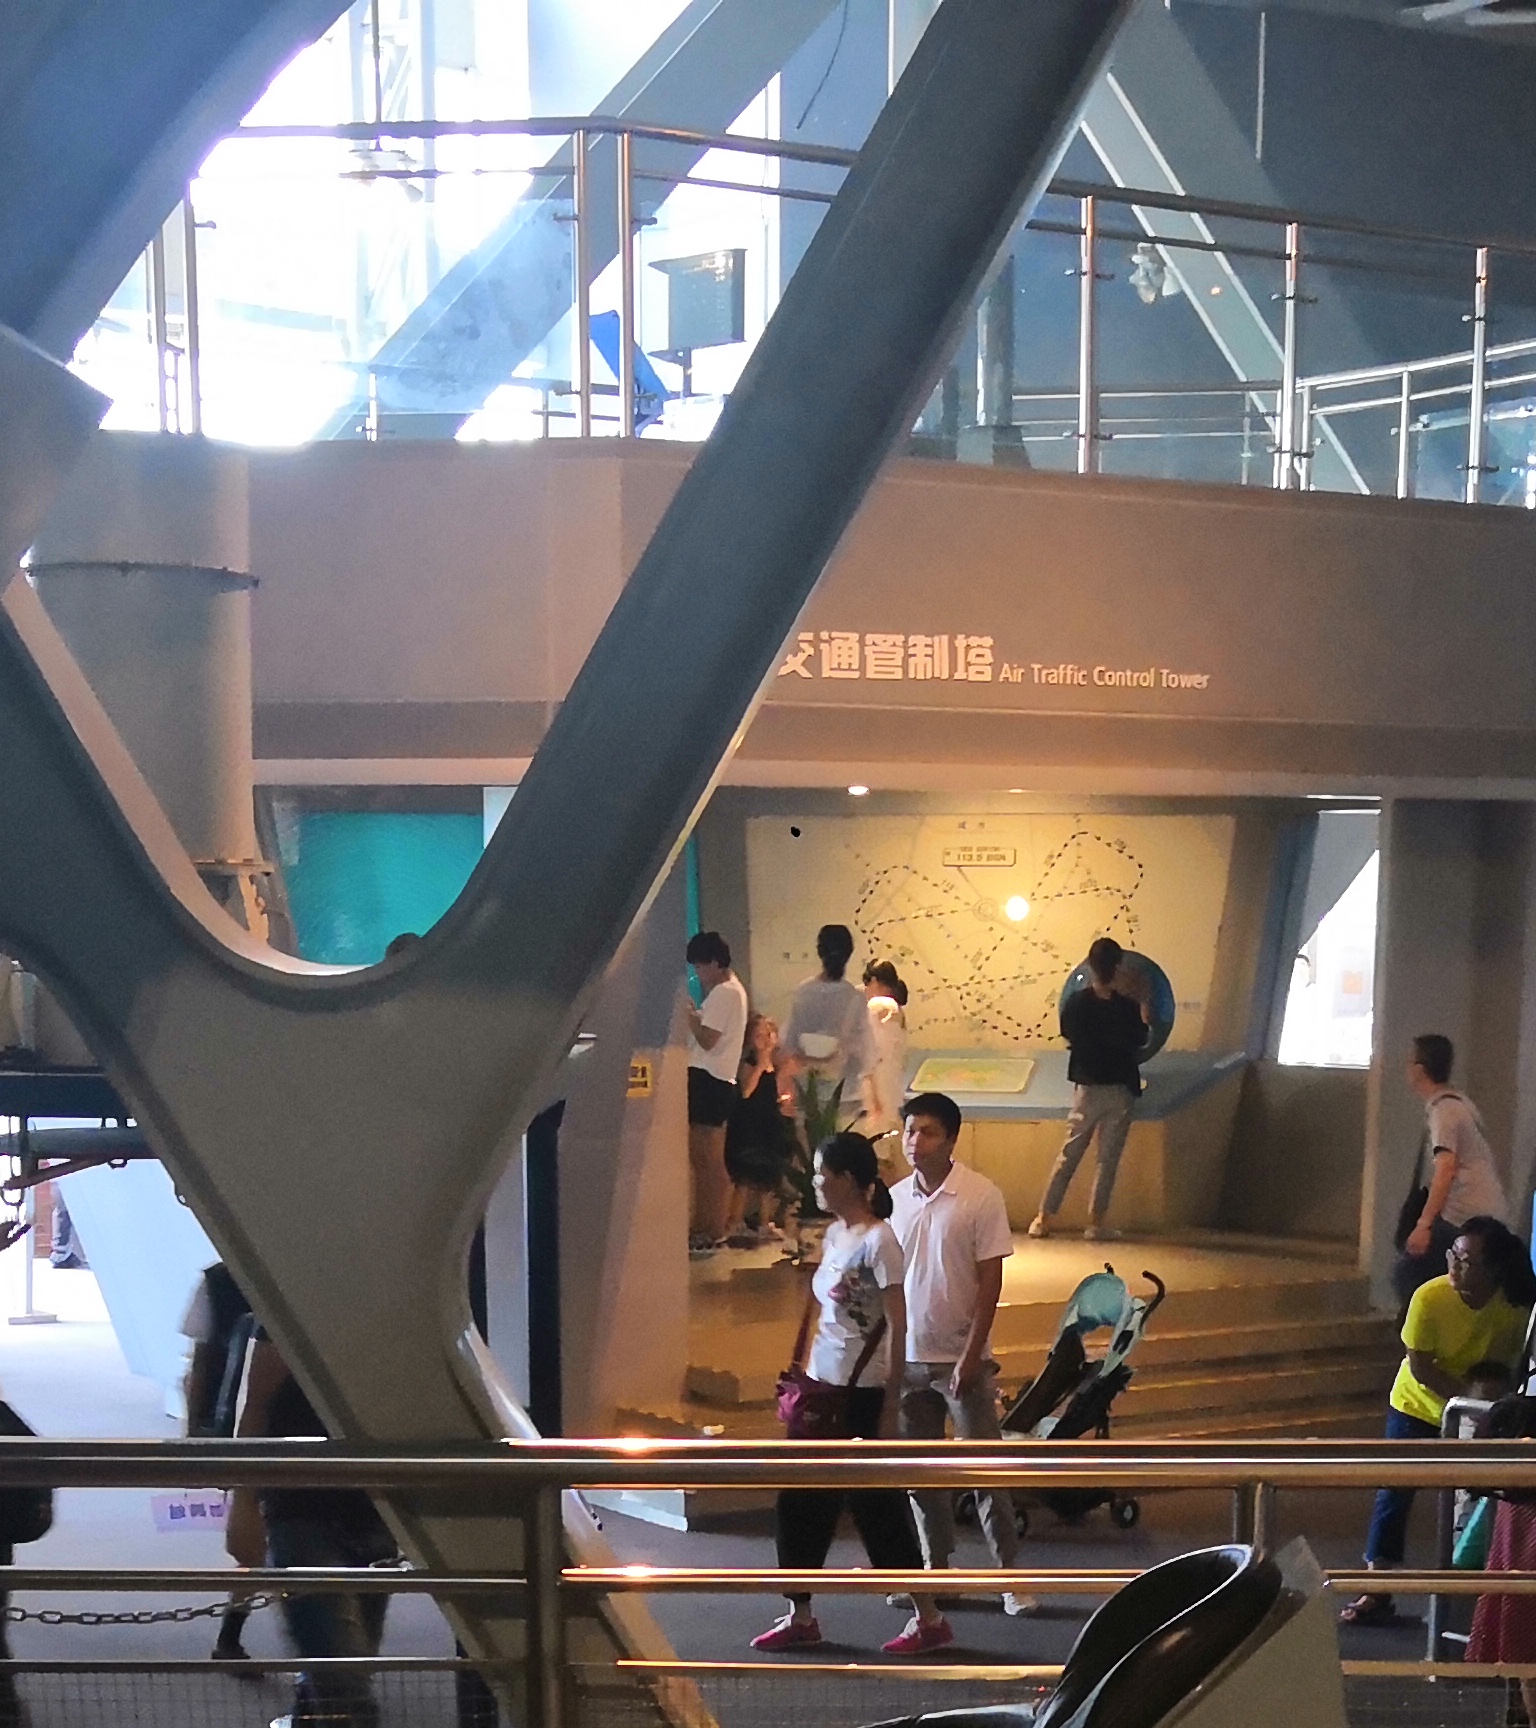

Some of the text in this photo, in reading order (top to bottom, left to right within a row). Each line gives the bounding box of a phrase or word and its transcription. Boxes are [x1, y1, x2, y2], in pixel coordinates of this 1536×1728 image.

[778, 632, 994, 681] 交通管制塔
[999, 663, 1209, 688] Air Traffic Control Tower
